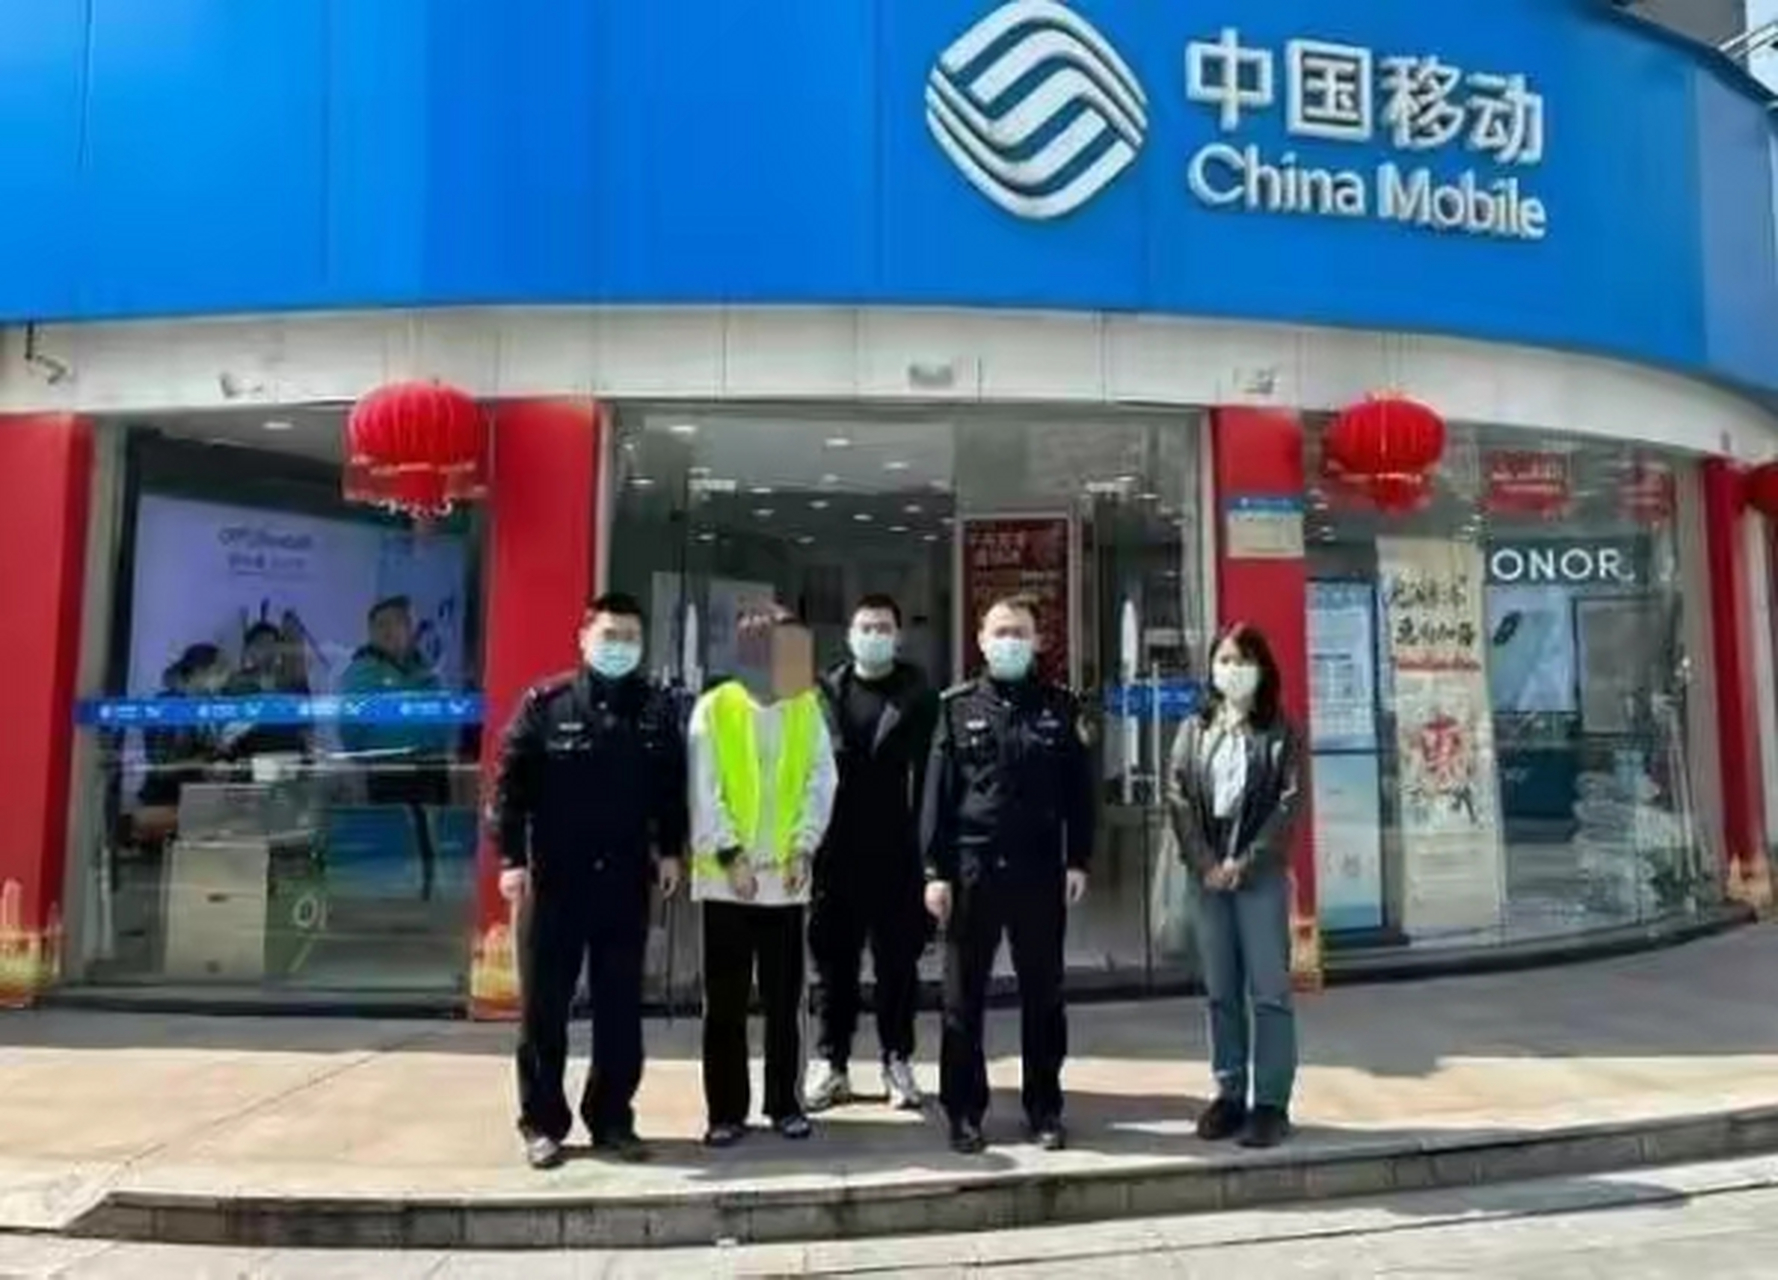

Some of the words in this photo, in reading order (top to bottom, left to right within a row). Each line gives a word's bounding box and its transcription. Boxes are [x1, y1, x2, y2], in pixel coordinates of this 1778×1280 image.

[1185, 26, 1543, 164] 中国移动
[1187, 142, 1366, 215] China
[1376, 161, 1547, 240] Mobile
[1491, 548, 1634, 581] ONOR
